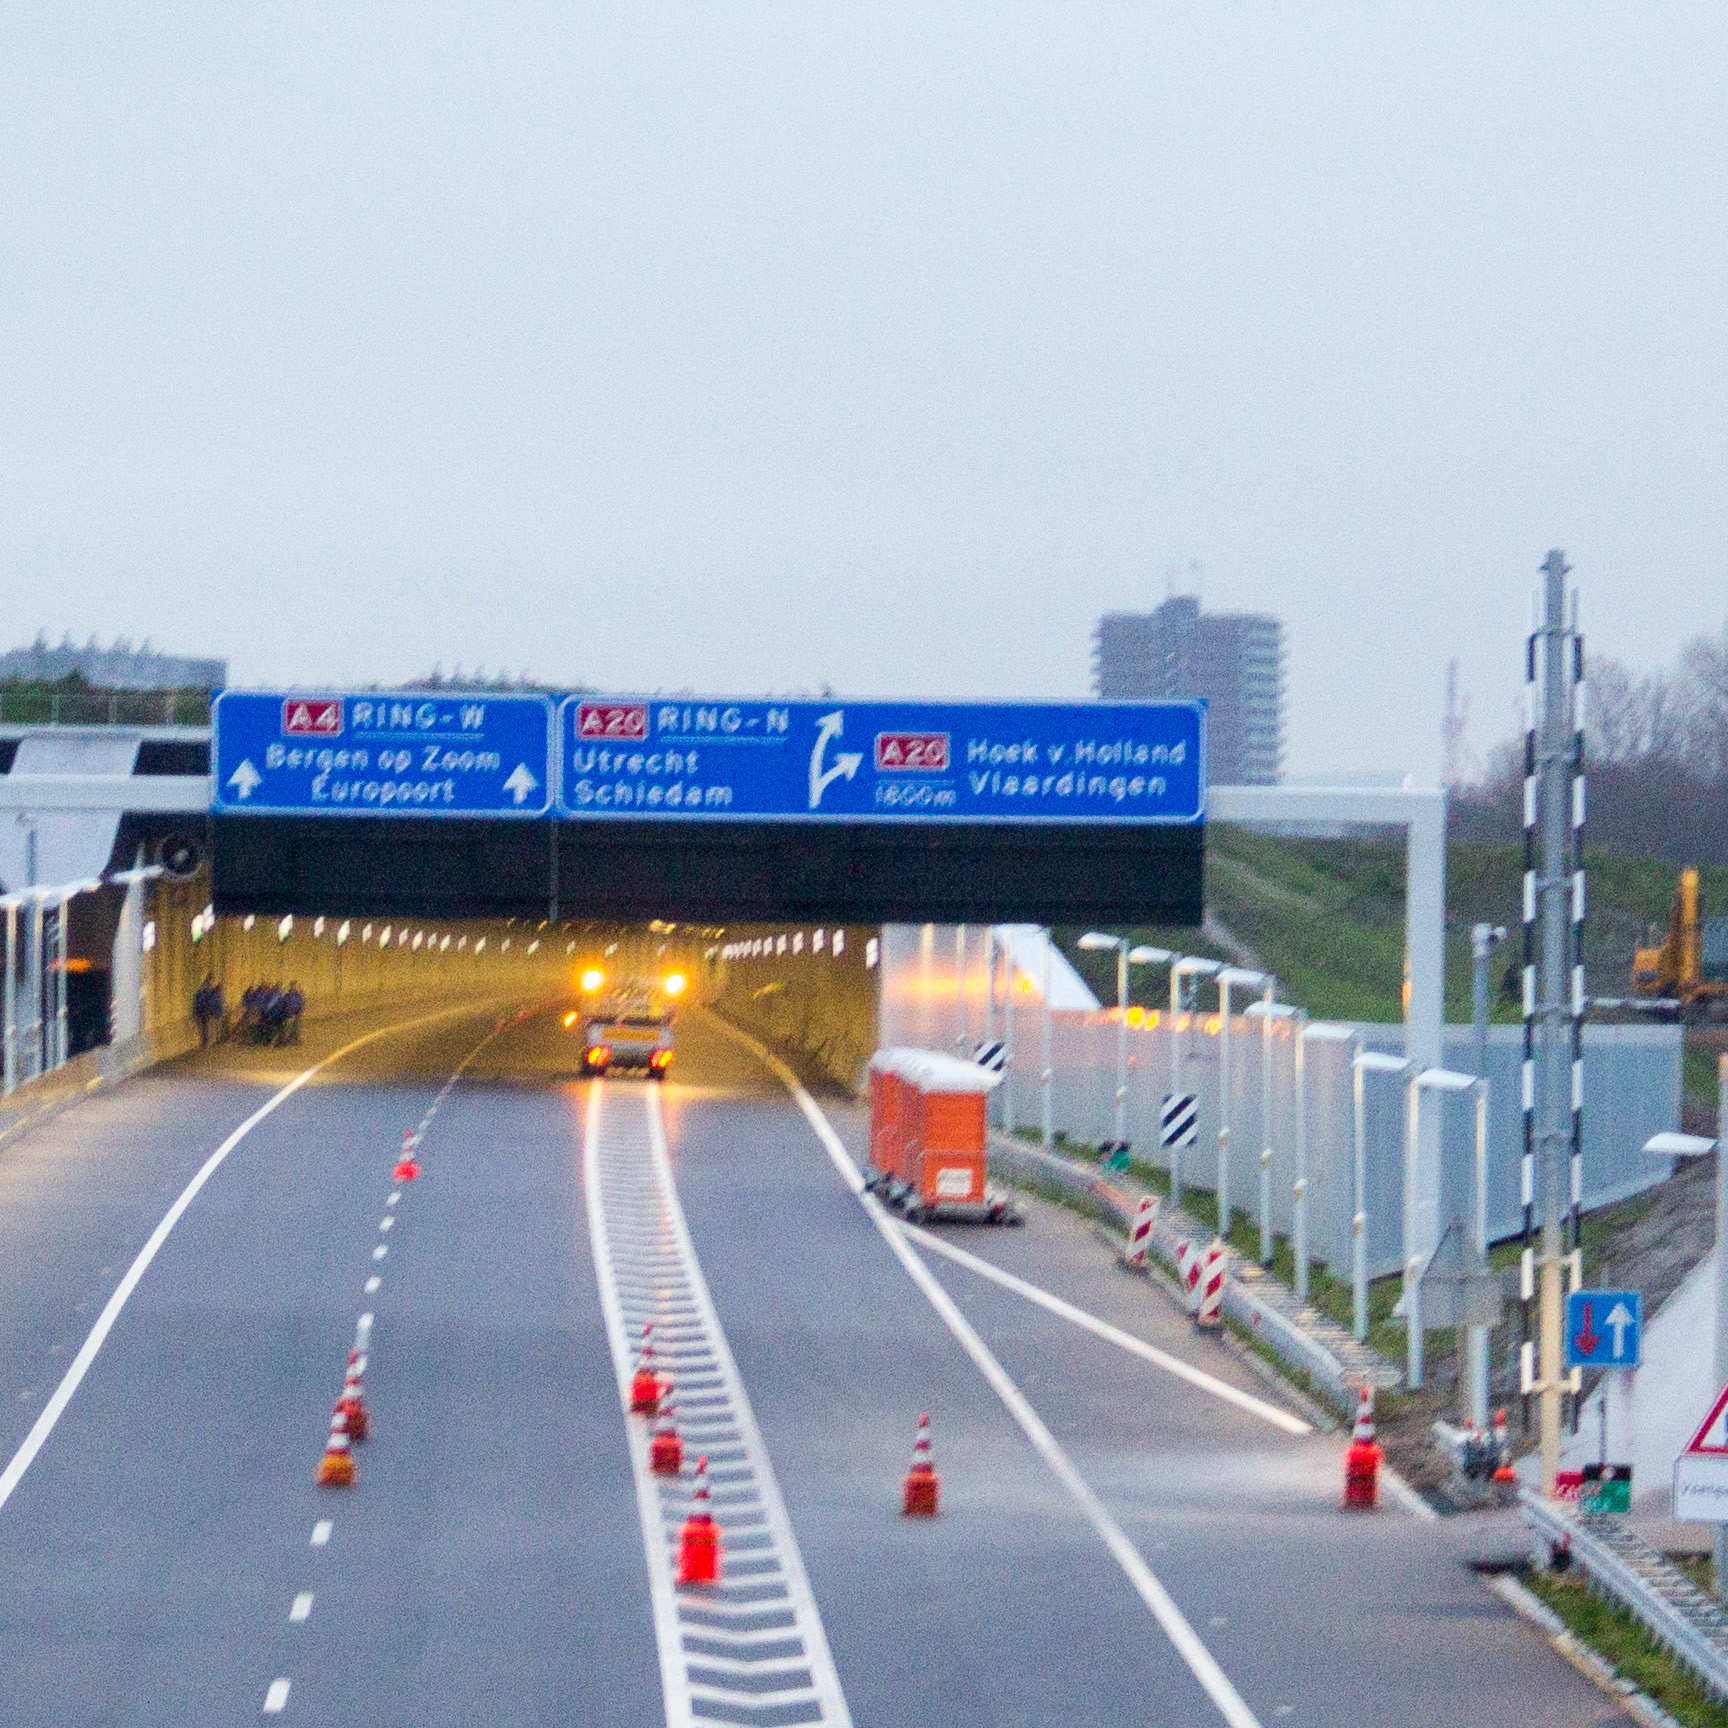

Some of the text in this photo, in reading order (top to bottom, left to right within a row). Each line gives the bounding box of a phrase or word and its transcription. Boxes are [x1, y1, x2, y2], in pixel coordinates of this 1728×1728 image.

[286, 702, 486, 730] A4 RING-W
[581, 706, 789, 736] A20 RING-N
[266, 744, 501, 773] Bergen op Zoom
[573, 748, 699, 774] Utrecht
[881, 738, 946, 767] A20
[968, 739, 1038, 765] Hoek
[311, 768, 455, 806] Europoort
[574, 780, 734, 806] Schiedam
[969, 770, 1167, 805] Vlaardingen
